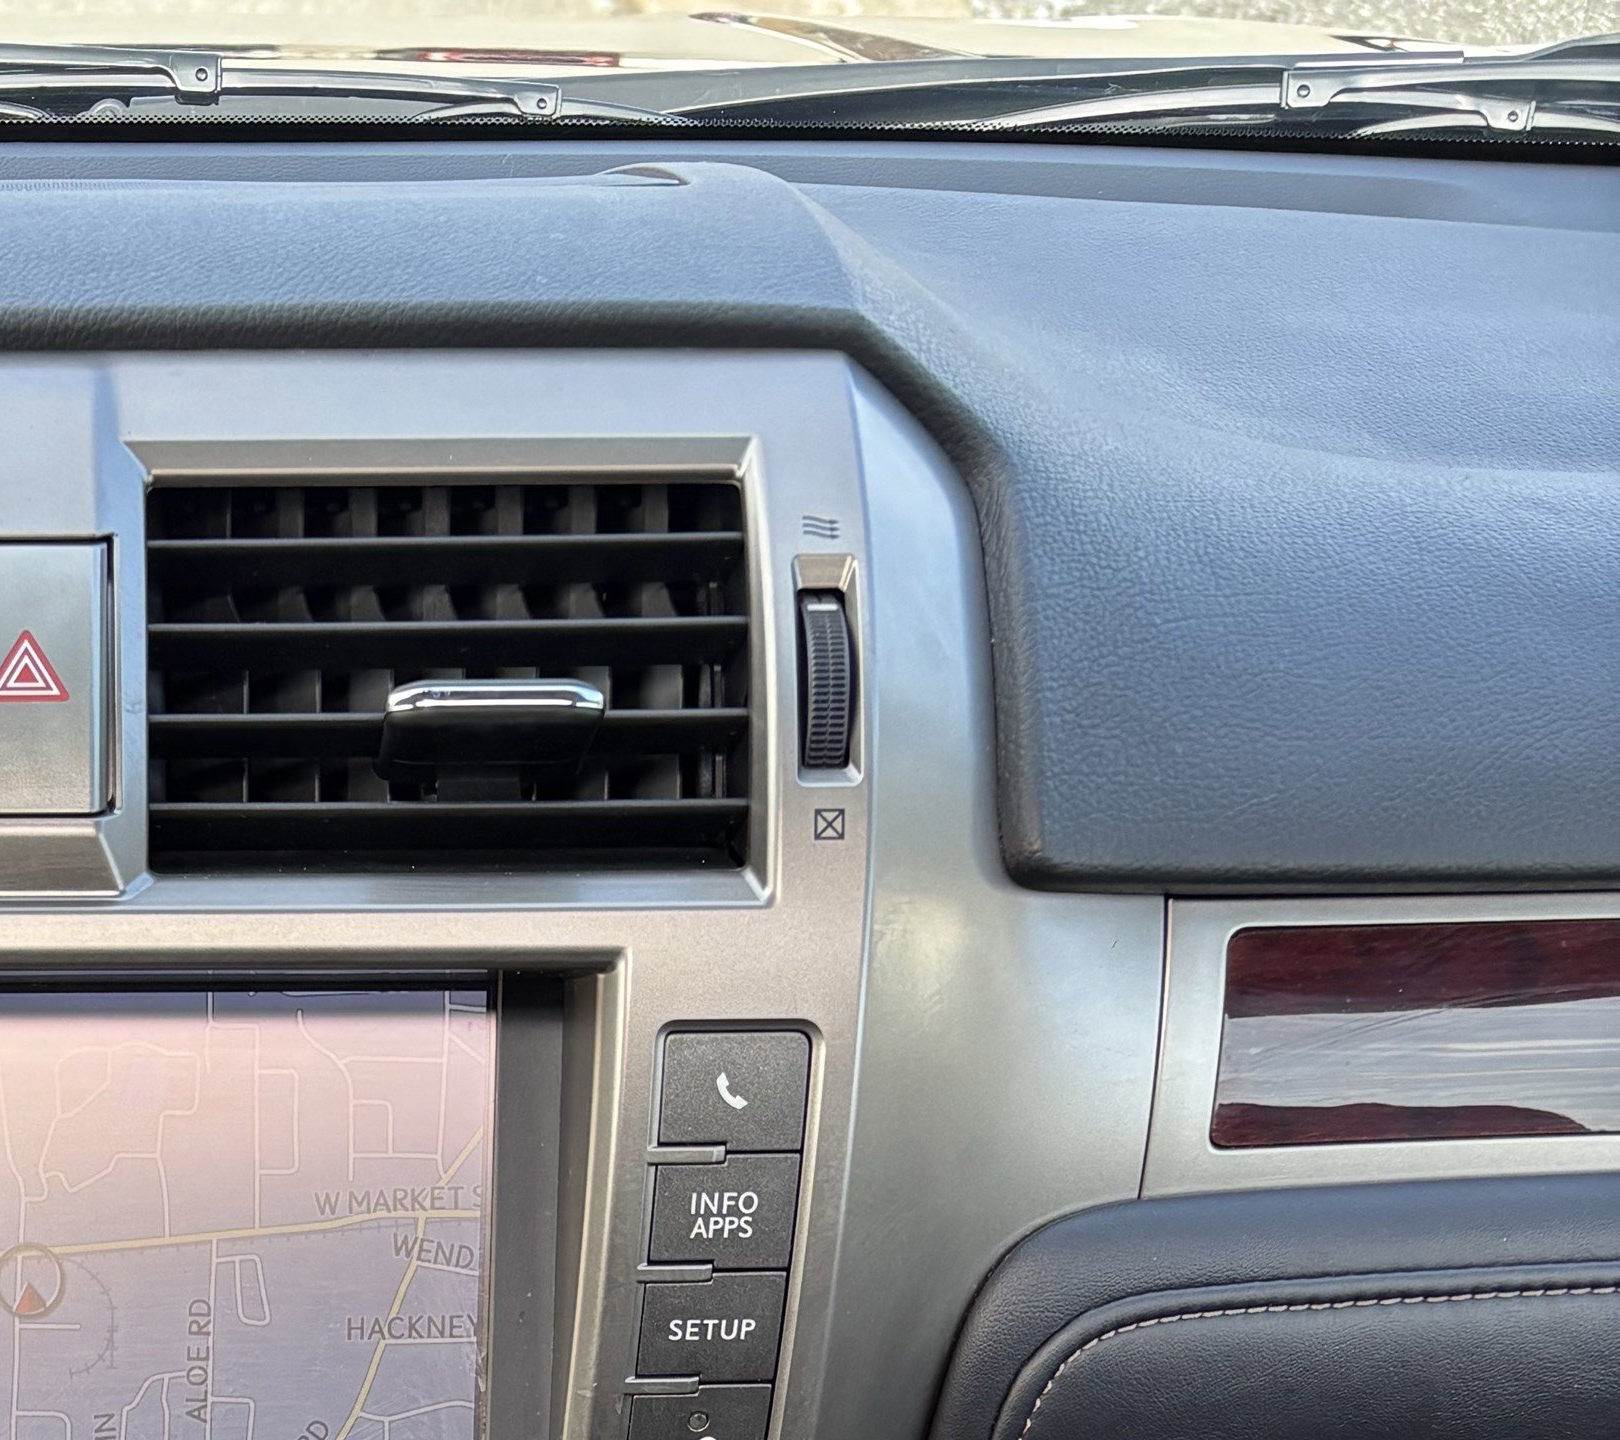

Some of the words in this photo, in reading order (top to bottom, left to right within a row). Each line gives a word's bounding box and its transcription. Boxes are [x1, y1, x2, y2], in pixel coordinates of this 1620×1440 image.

[314, 1191, 340, 1216] W
[348, 1186, 464, 1214] MARKET
[690, 1191, 759, 1215] INFO
[689, 1216, 753, 1239] APPS
[393, 1232, 475, 1269] WEND
[188, 1299, 212, 1337] RD
[347, 1313, 478, 1340] HACKNEY
[668, 1319, 756, 1342] SETUP
[185, 1344, 210, 1422] ALOE
